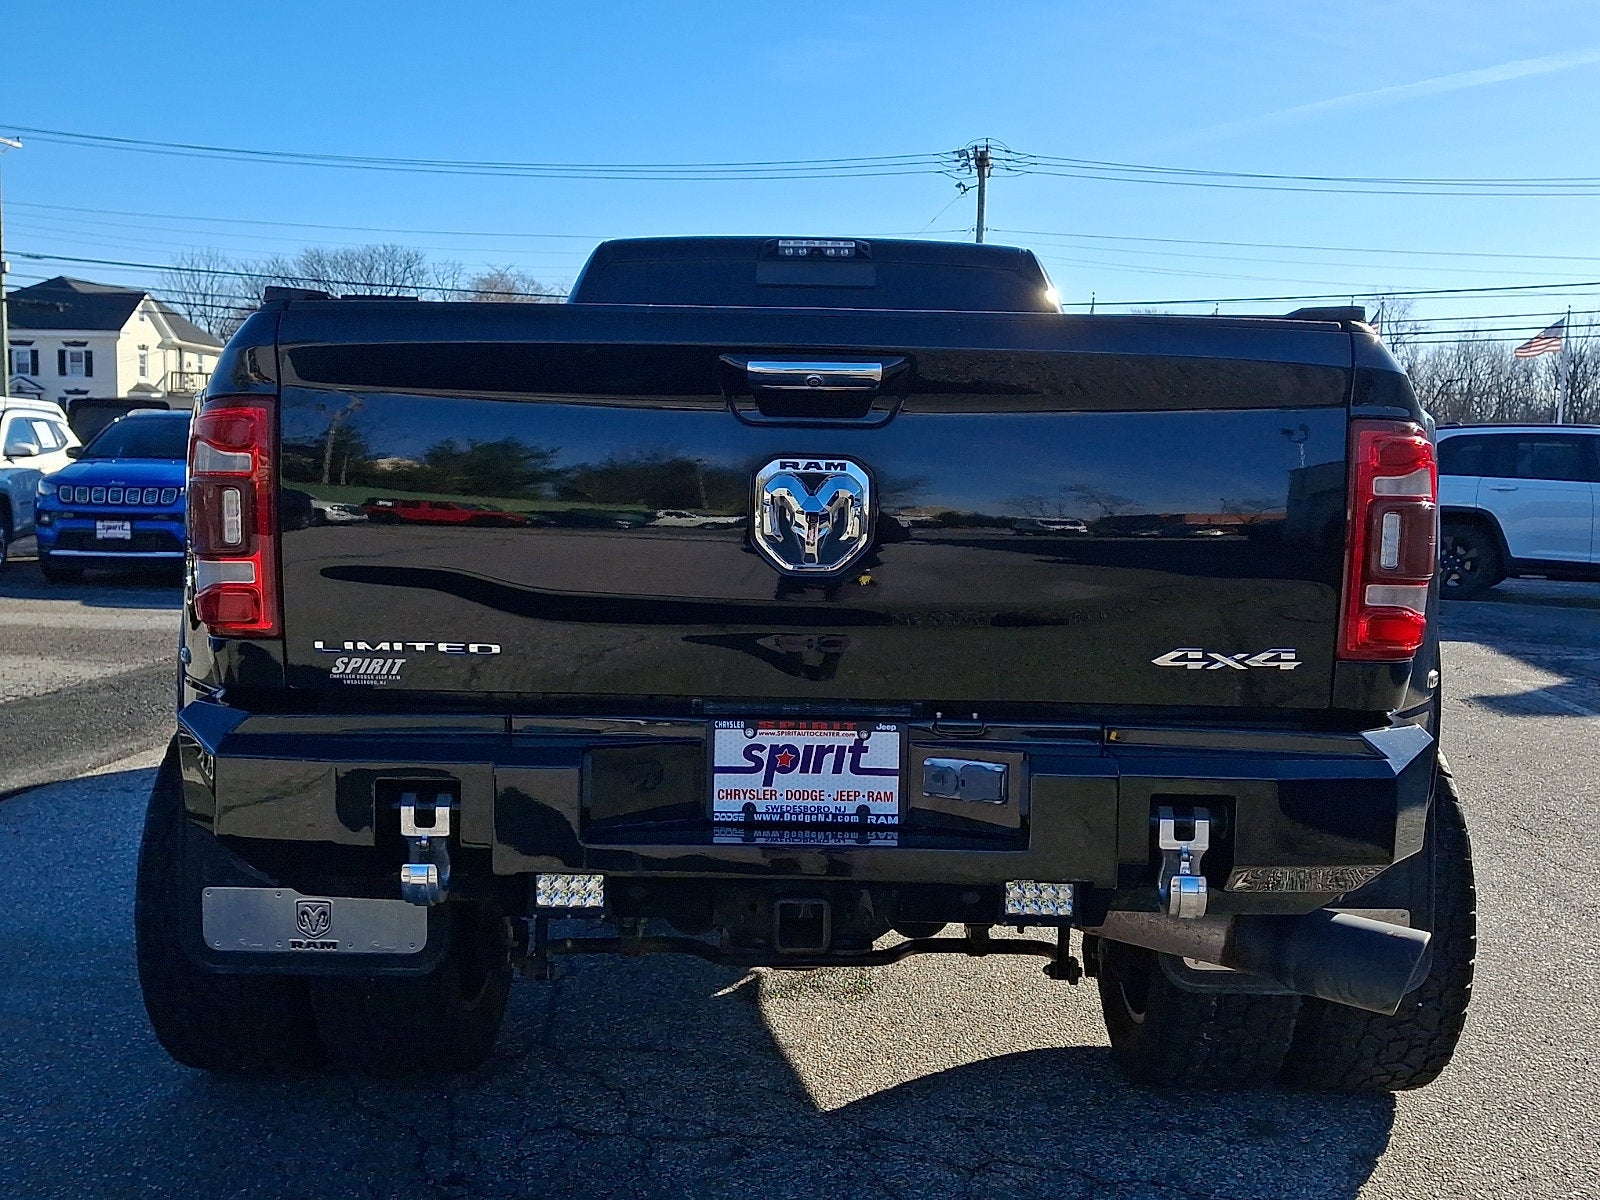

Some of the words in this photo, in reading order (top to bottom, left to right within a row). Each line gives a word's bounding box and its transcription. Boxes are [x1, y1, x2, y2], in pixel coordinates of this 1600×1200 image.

[779, 461, 847, 471] RAM
[313, 640, 501, 655] LIMITED
[331, 657, 407, 675] SPIRIT
[714, 720, 745, 730] CHRYSLER
[758, 720, 857, 730] SPIRIT
[875, 722, 897, 731] Jeep
[758, 730, 856, 738] www.SPIRITAUTOCENTER.com
[742, 738, 870, 788] spirit
[717, 788, 778, 801] CHRYSLER
[785, 789, 825, 802] DODGE
[832, 790, 861, 802] JEEP
[866, 790, 894, 803] RAM
[834, 805, 847, 814] NJ
[713, 812, 746, 822] DODGE
[753, 812, 860, 823] www.DodgeNJ.com
[866, 815, 899, 825] RAM
[289, 940, 338, 951] RAM
